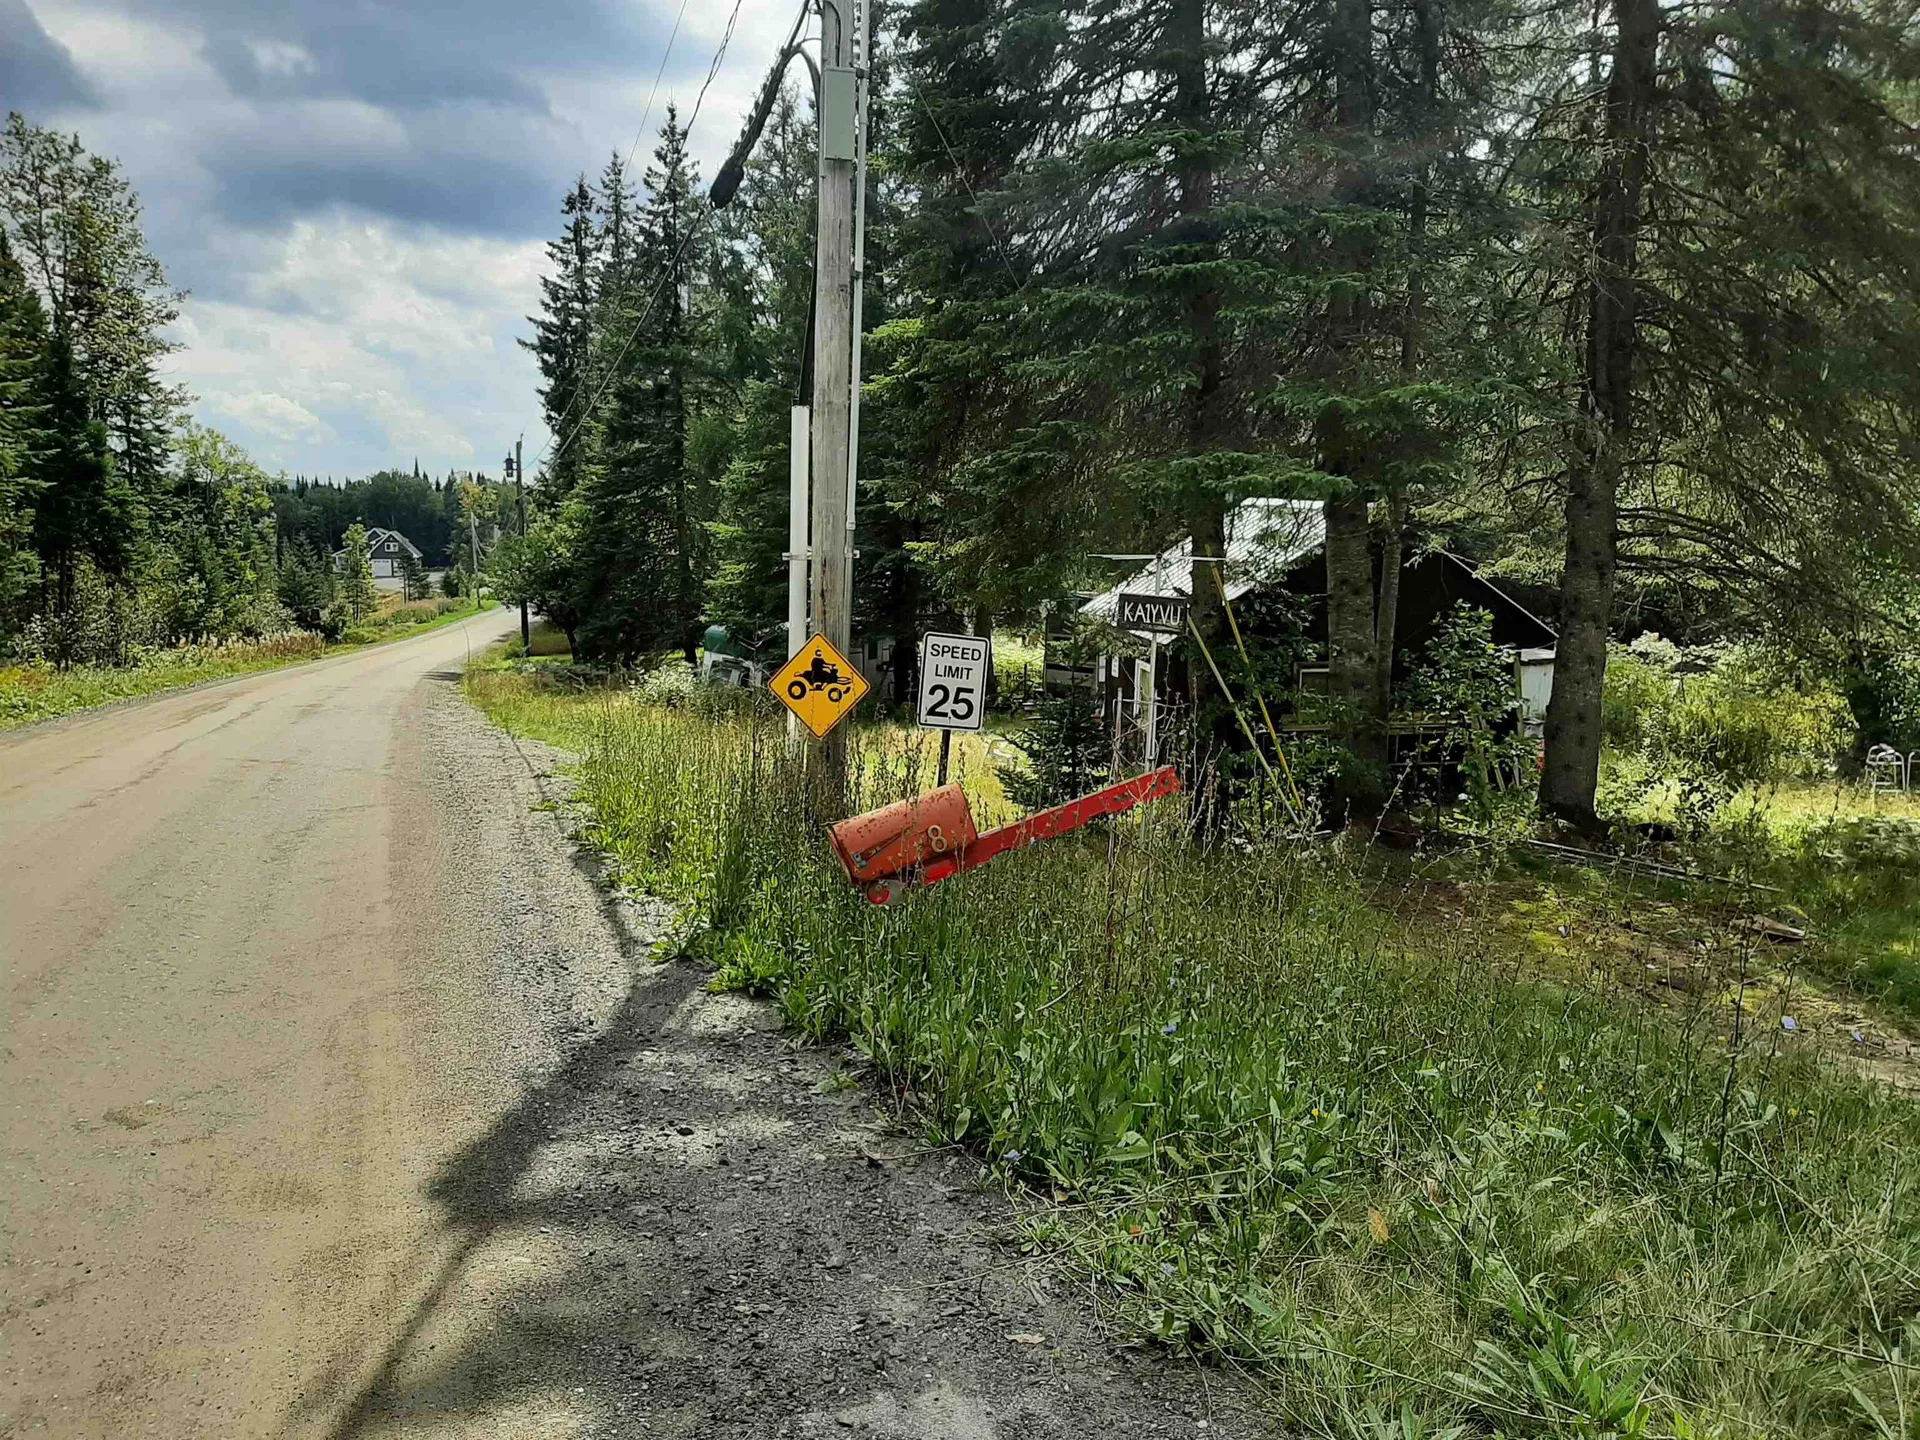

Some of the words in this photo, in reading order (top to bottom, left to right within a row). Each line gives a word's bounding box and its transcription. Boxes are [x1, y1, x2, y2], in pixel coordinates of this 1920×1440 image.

[1124, 601, 1181, 626] KA1YVU
[930, 643, 982, 661] SPEED
[935, 664, 973, 680] LIMIT
[925, 684, 974, 720] 25
[927, 824, 948, 852] 8
